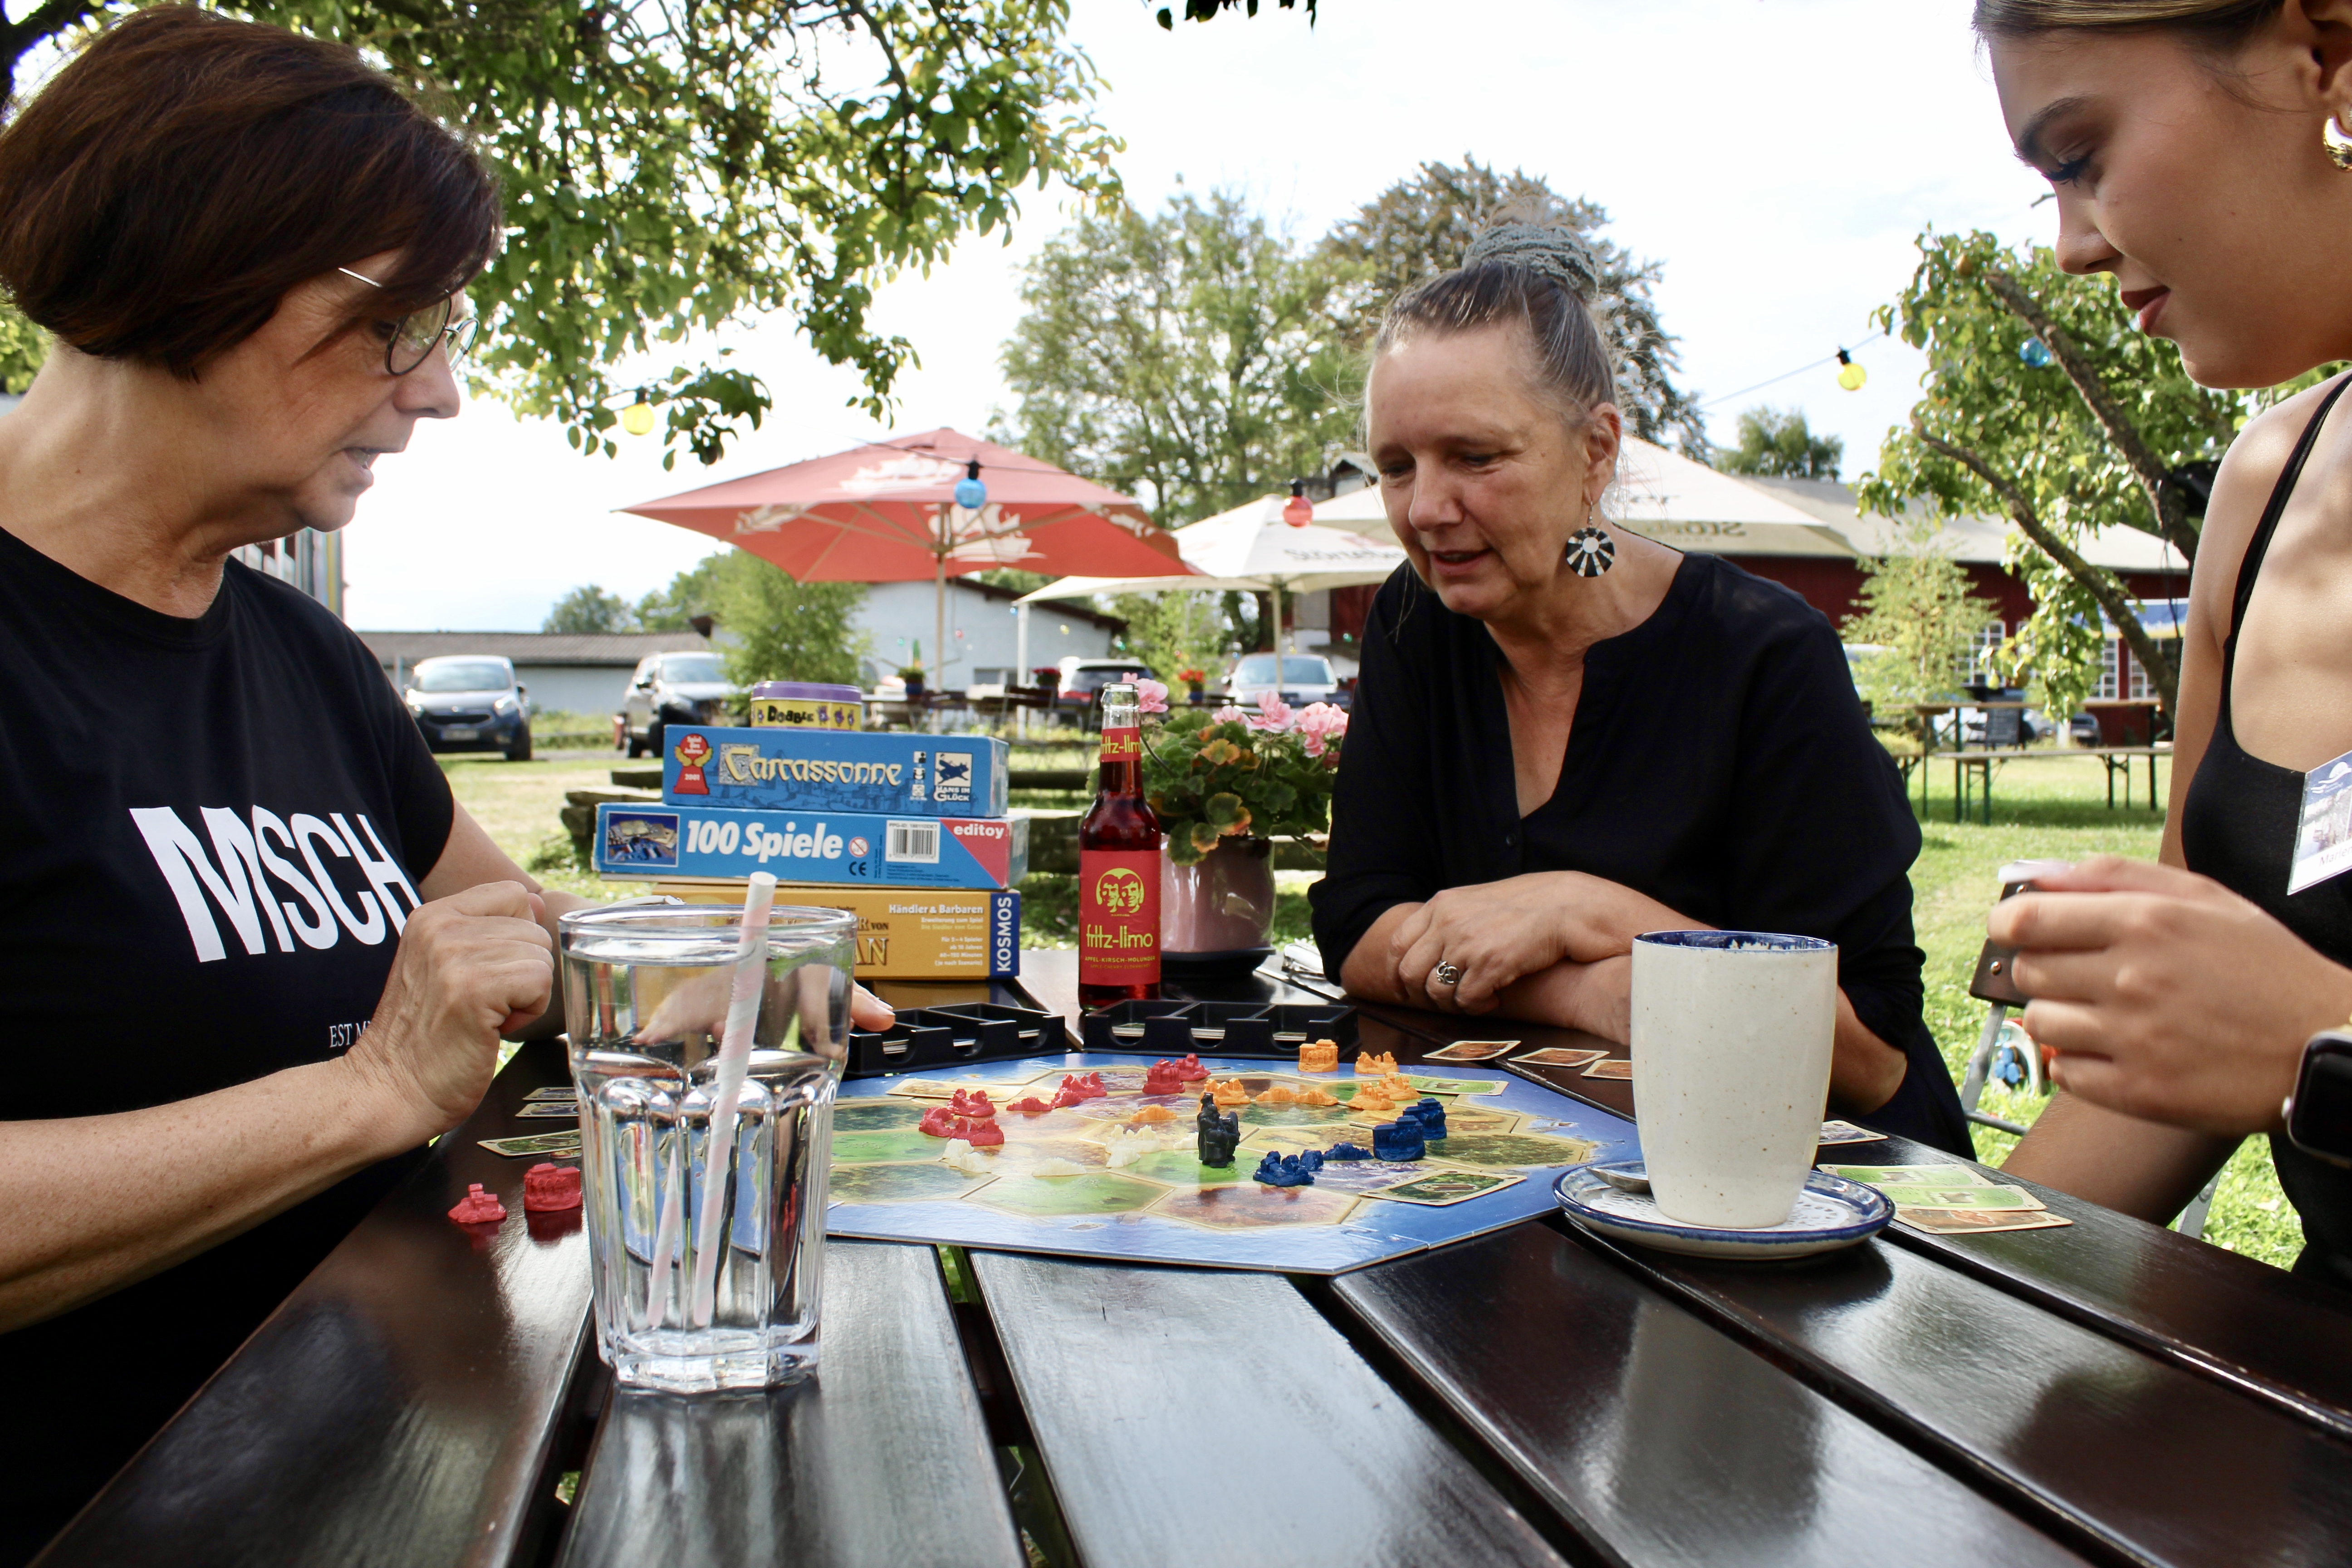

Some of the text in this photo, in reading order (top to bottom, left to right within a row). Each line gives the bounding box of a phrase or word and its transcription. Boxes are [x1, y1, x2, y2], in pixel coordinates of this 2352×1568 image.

[725, 747, 902, 786] Carcassonne
[686, 820, 740, 854] 100
[741, 822, 843, 863] Spiele
[953, 823, 1004, 838] editoy
[129, 804, 424, 963] MSCH
[889, 904, 928, 913] Händler
[939, 904, 984, 913] Barbaren
[997, 897, 1012, 971] KOSMOS
[1086, 924, 1153, 948] fritz-limo
[329, 1023, 353, 1048] EST
